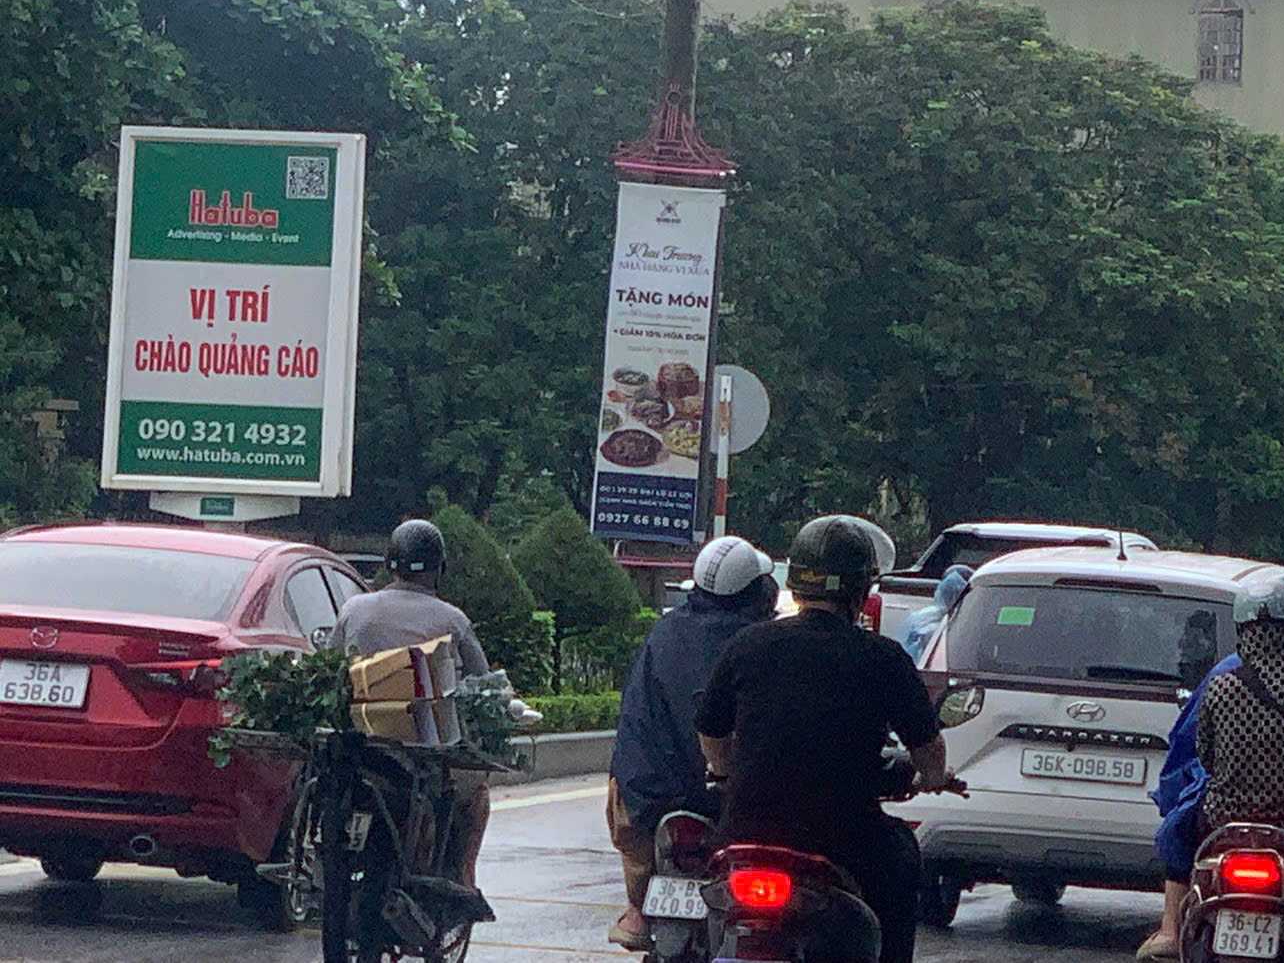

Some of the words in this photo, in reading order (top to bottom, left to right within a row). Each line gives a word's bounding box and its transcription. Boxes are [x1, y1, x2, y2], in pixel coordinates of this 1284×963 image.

[189, 189, 279, 229] Hatuba
[167, 228, 222, 243] Advertising
[190, 288, 216, 328] VỊ
[226, 285, 270, 323] TRÍ
[616, 287, 663, 308] TẶNG
[668, 291, 709, 309] MÓN
[135, 335, 191, 373] CHÀO
[199, 333, 269, 378] QUẢNG
[276, 339, 319, 378] CÁO
[138, 418, 185, 441] 090
[191, 420, 237, 443] 321
[244, 422, 306, 446] 4932
[136, 446, 306, 467] www.hatuba.com.vn
[598, 512, 630, 524] 0927
[24, 663, 61, 683] 36A
[1017, 726, 1151, 745] STARGAZER
